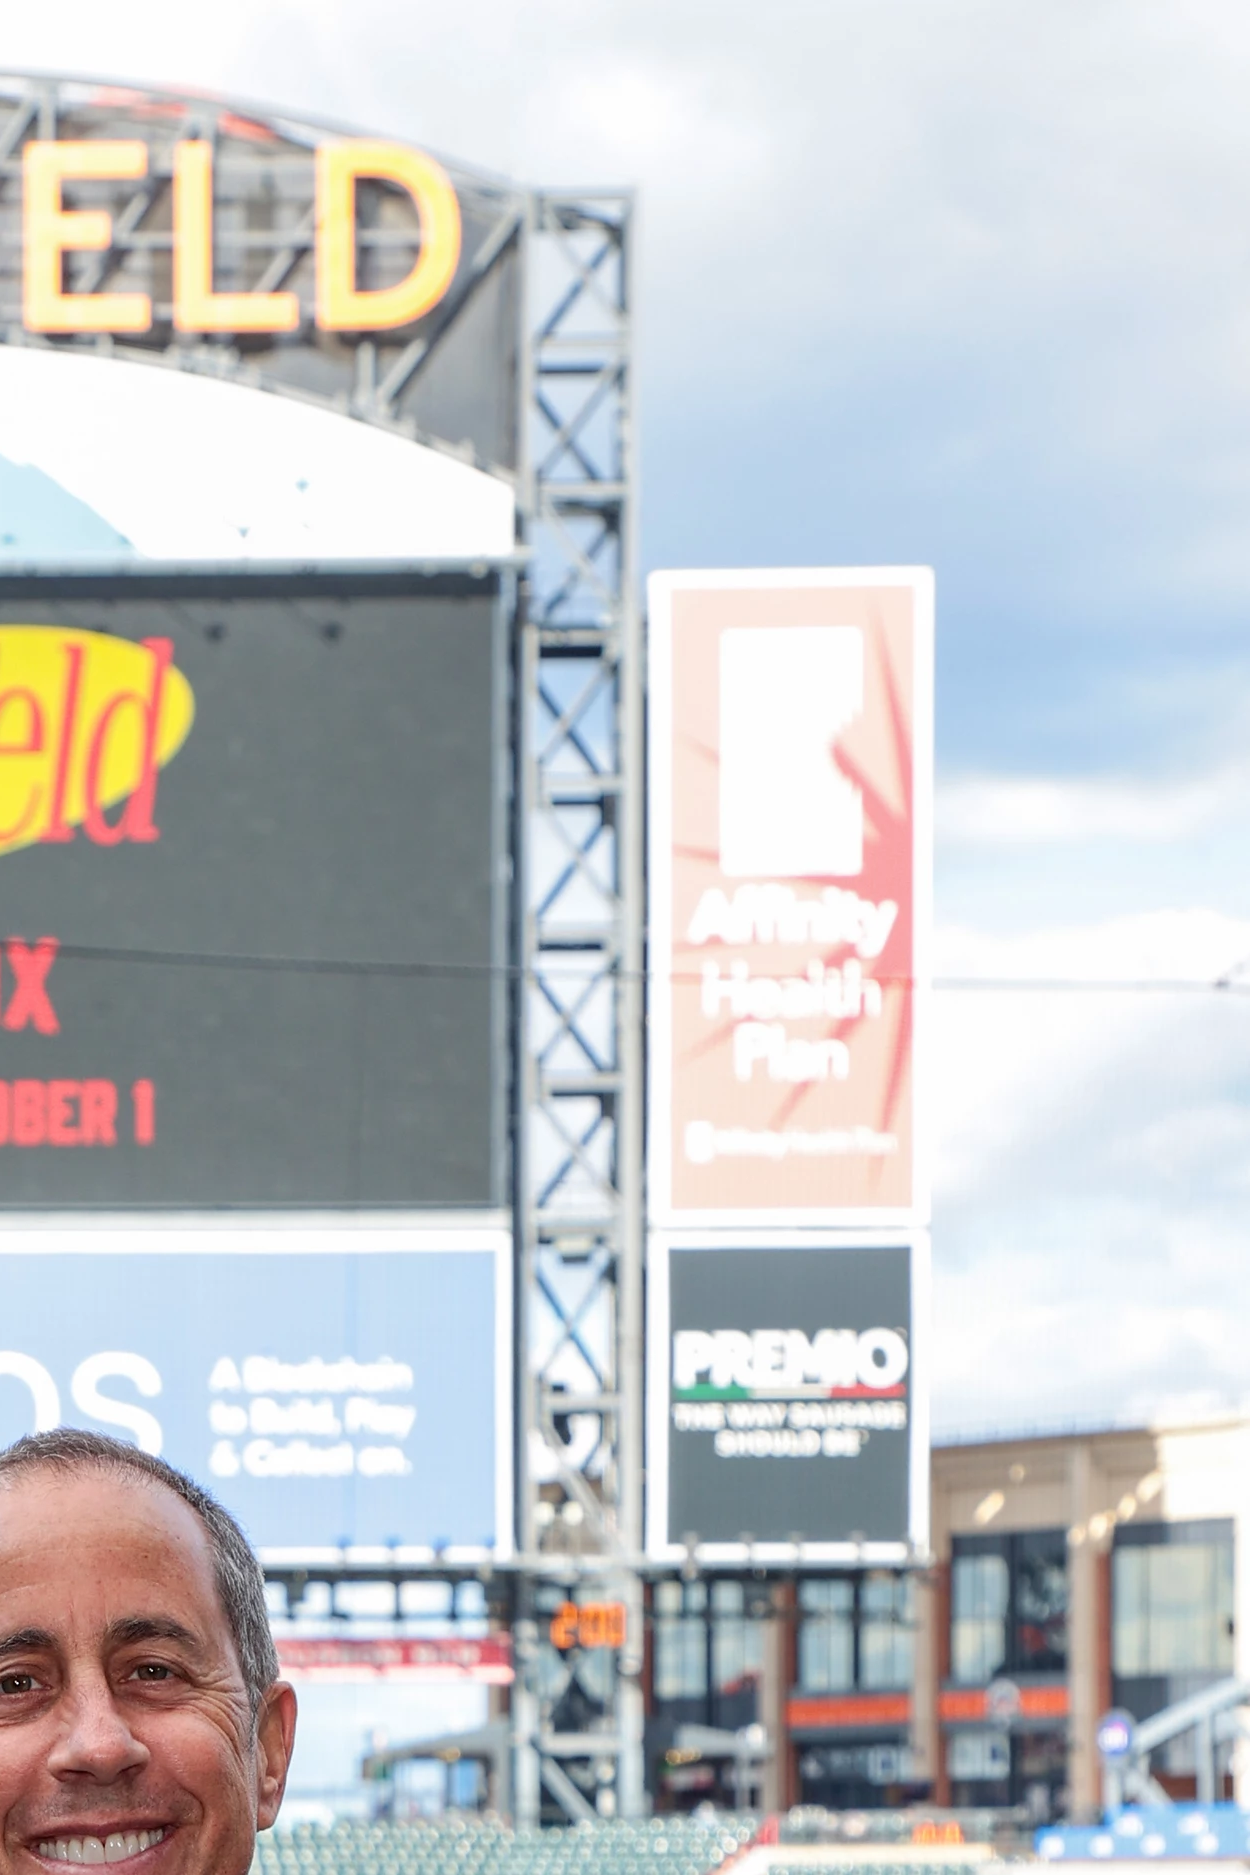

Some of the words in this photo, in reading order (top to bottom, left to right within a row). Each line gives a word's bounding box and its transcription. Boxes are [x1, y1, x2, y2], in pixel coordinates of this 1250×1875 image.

[686, 882, 899, 959] Affinity
[701, 957, 882, 1019] Health
[732, 1021, 850, 1082] Plan
[132, 1079, 155, 1148] 1
[672, 1326, 909, 1391] PREMIO
